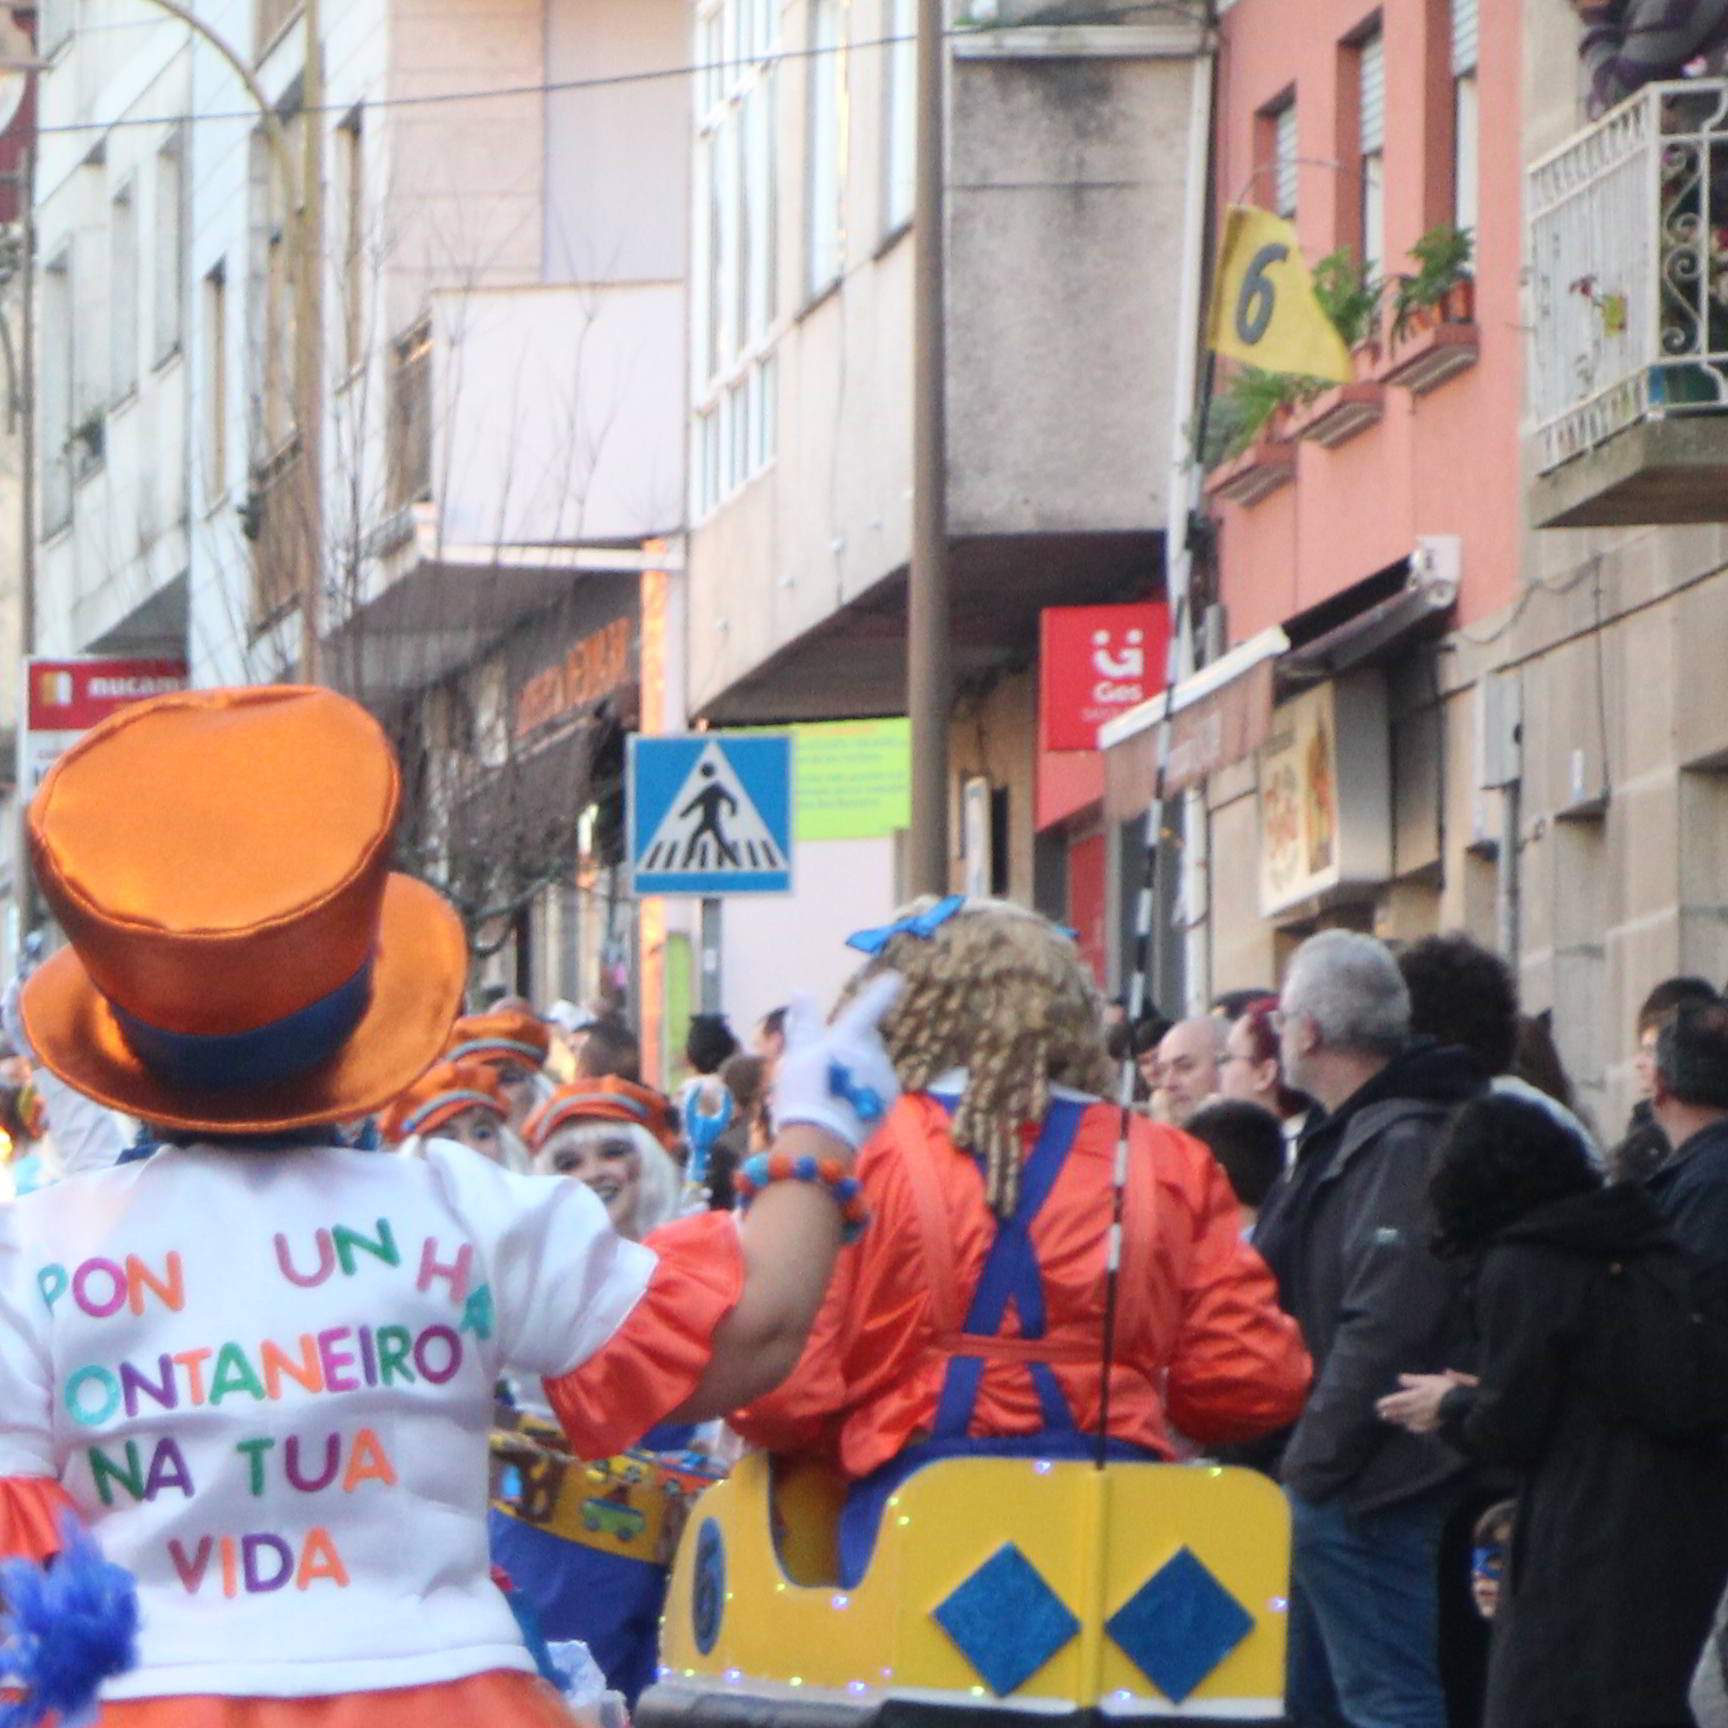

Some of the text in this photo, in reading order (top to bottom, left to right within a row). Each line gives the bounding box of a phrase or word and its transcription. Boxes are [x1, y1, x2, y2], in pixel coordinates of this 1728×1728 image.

[1235, 242, 1290, 346] 6
[36, 1250, 187, 1321] PON
[87, 1428, 399, 1505] NA TUA
[166, 1526, 351, 1600] VIDA
